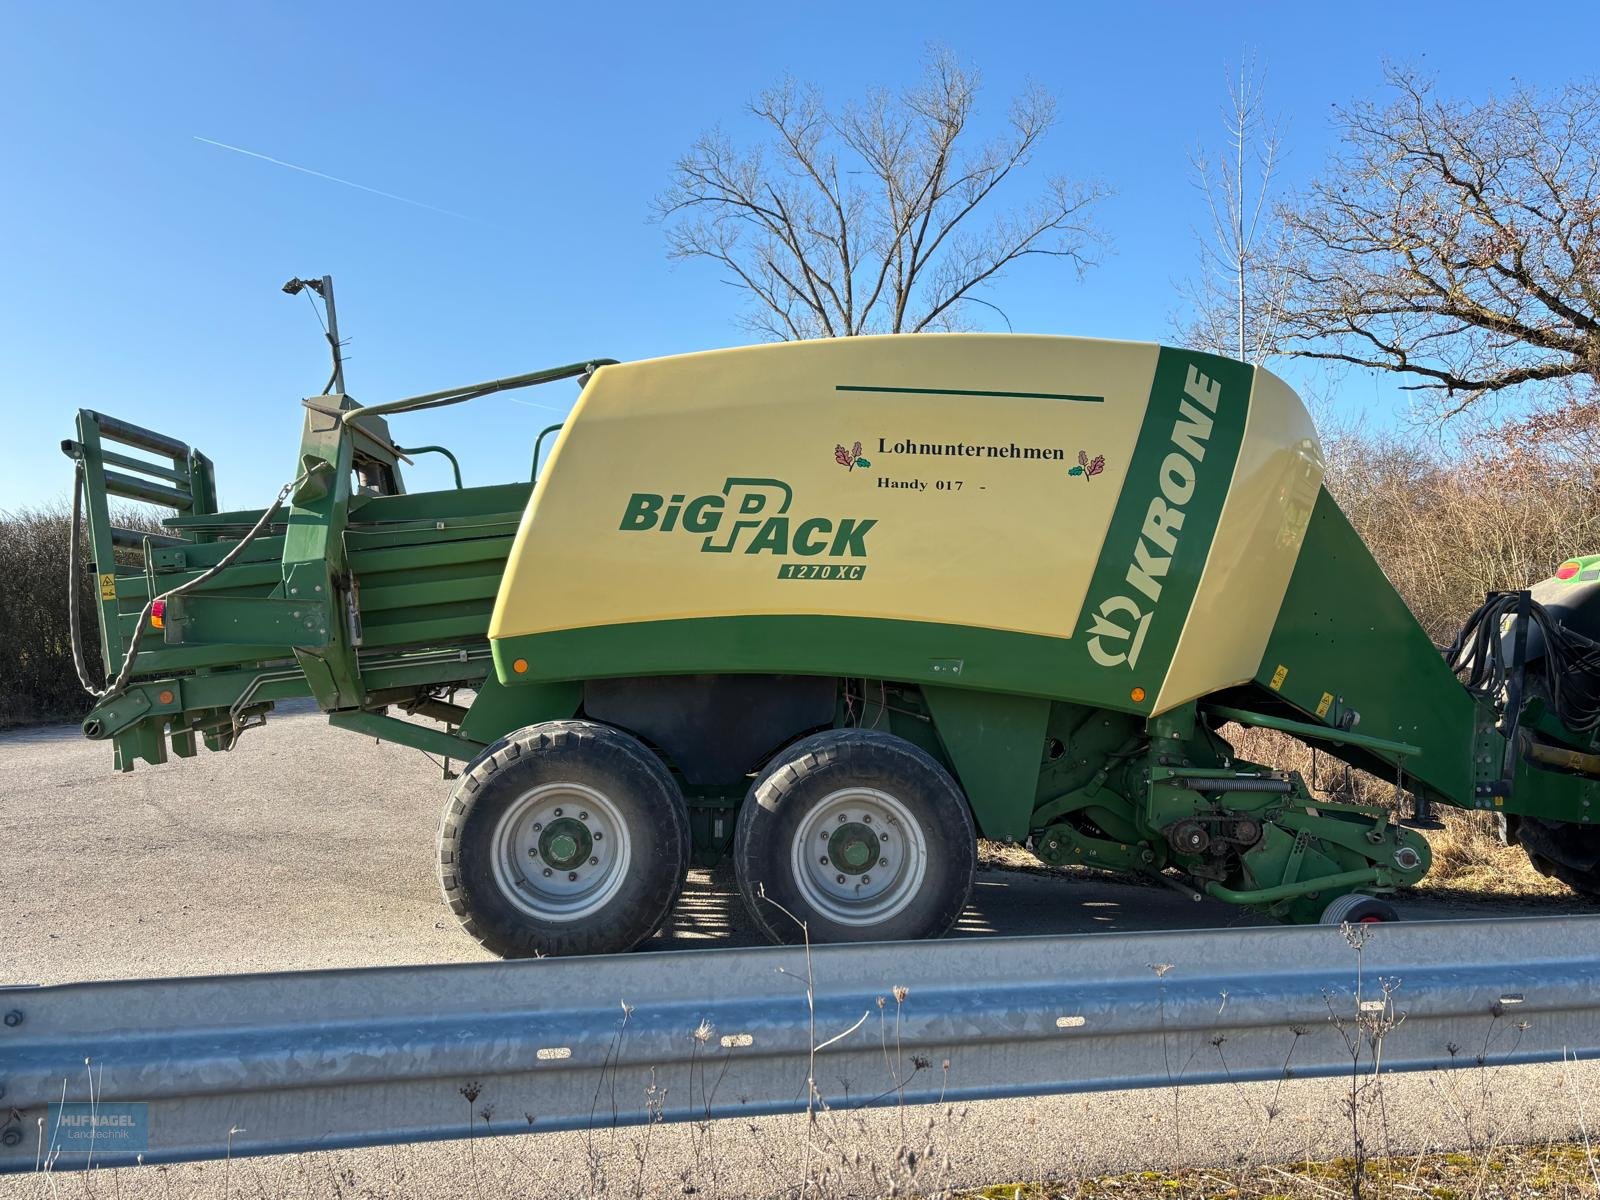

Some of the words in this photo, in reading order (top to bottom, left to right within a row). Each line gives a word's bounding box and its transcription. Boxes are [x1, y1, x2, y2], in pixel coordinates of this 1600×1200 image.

[878, 437, 1064, 460] Lohnunternehmen
[877, 477, 928, 492] Handy
[935, 480, 963, 491] 017
[1125, 363, 1221, 602] KRONE
[701, 477, 879, 557] PACK
[788, 565, 829, 579] 1270
[836, 566, 861, 579] XC
